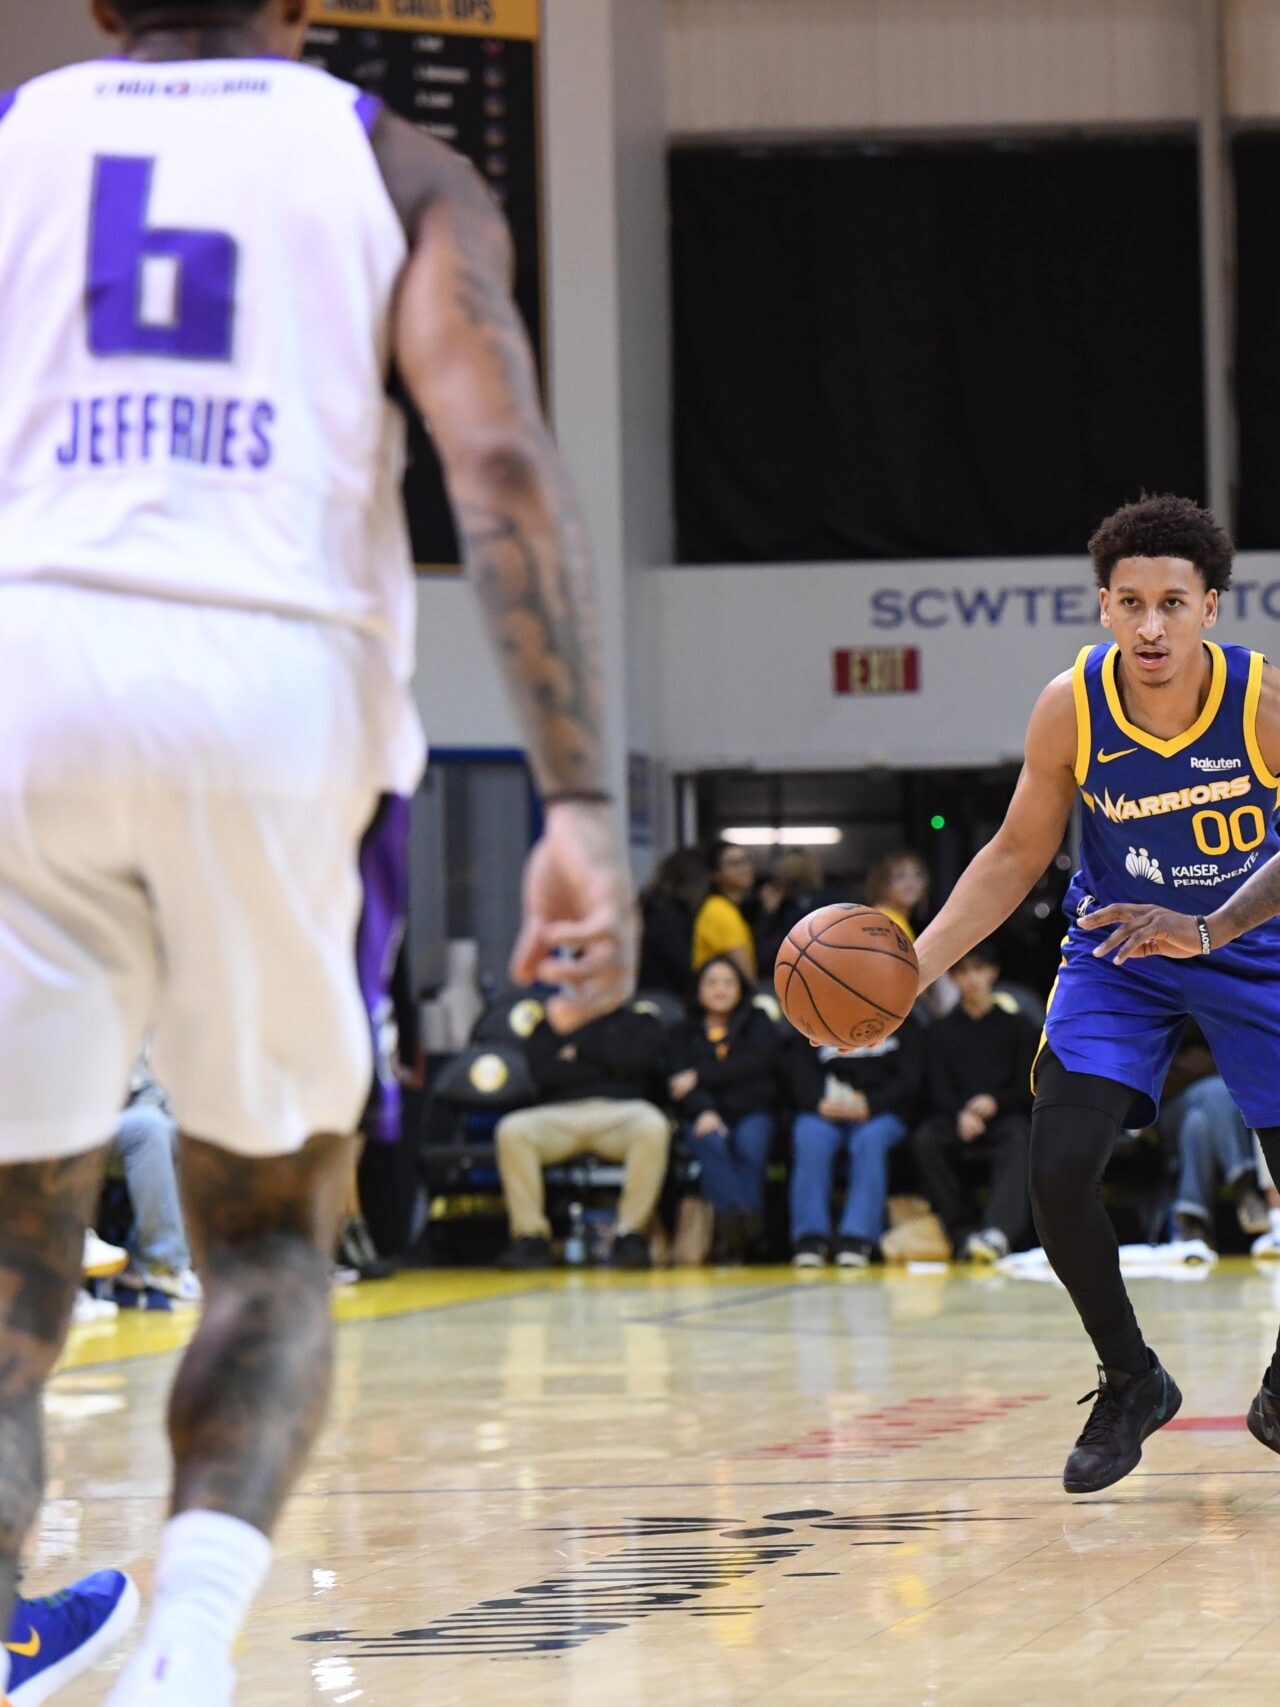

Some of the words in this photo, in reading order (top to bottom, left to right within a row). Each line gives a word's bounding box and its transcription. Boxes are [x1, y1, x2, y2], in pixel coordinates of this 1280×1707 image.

[86, 154, 237, 362] 6
[56, 394, 275, 470] JEFFRIES
[1190, 757, 1241, 772] Rakuten
[1093, 774, 1252, 824] WARRIORS
[1191, 805, 1266, 856] 00
[1171, 864, 1219, 877] KAISER
